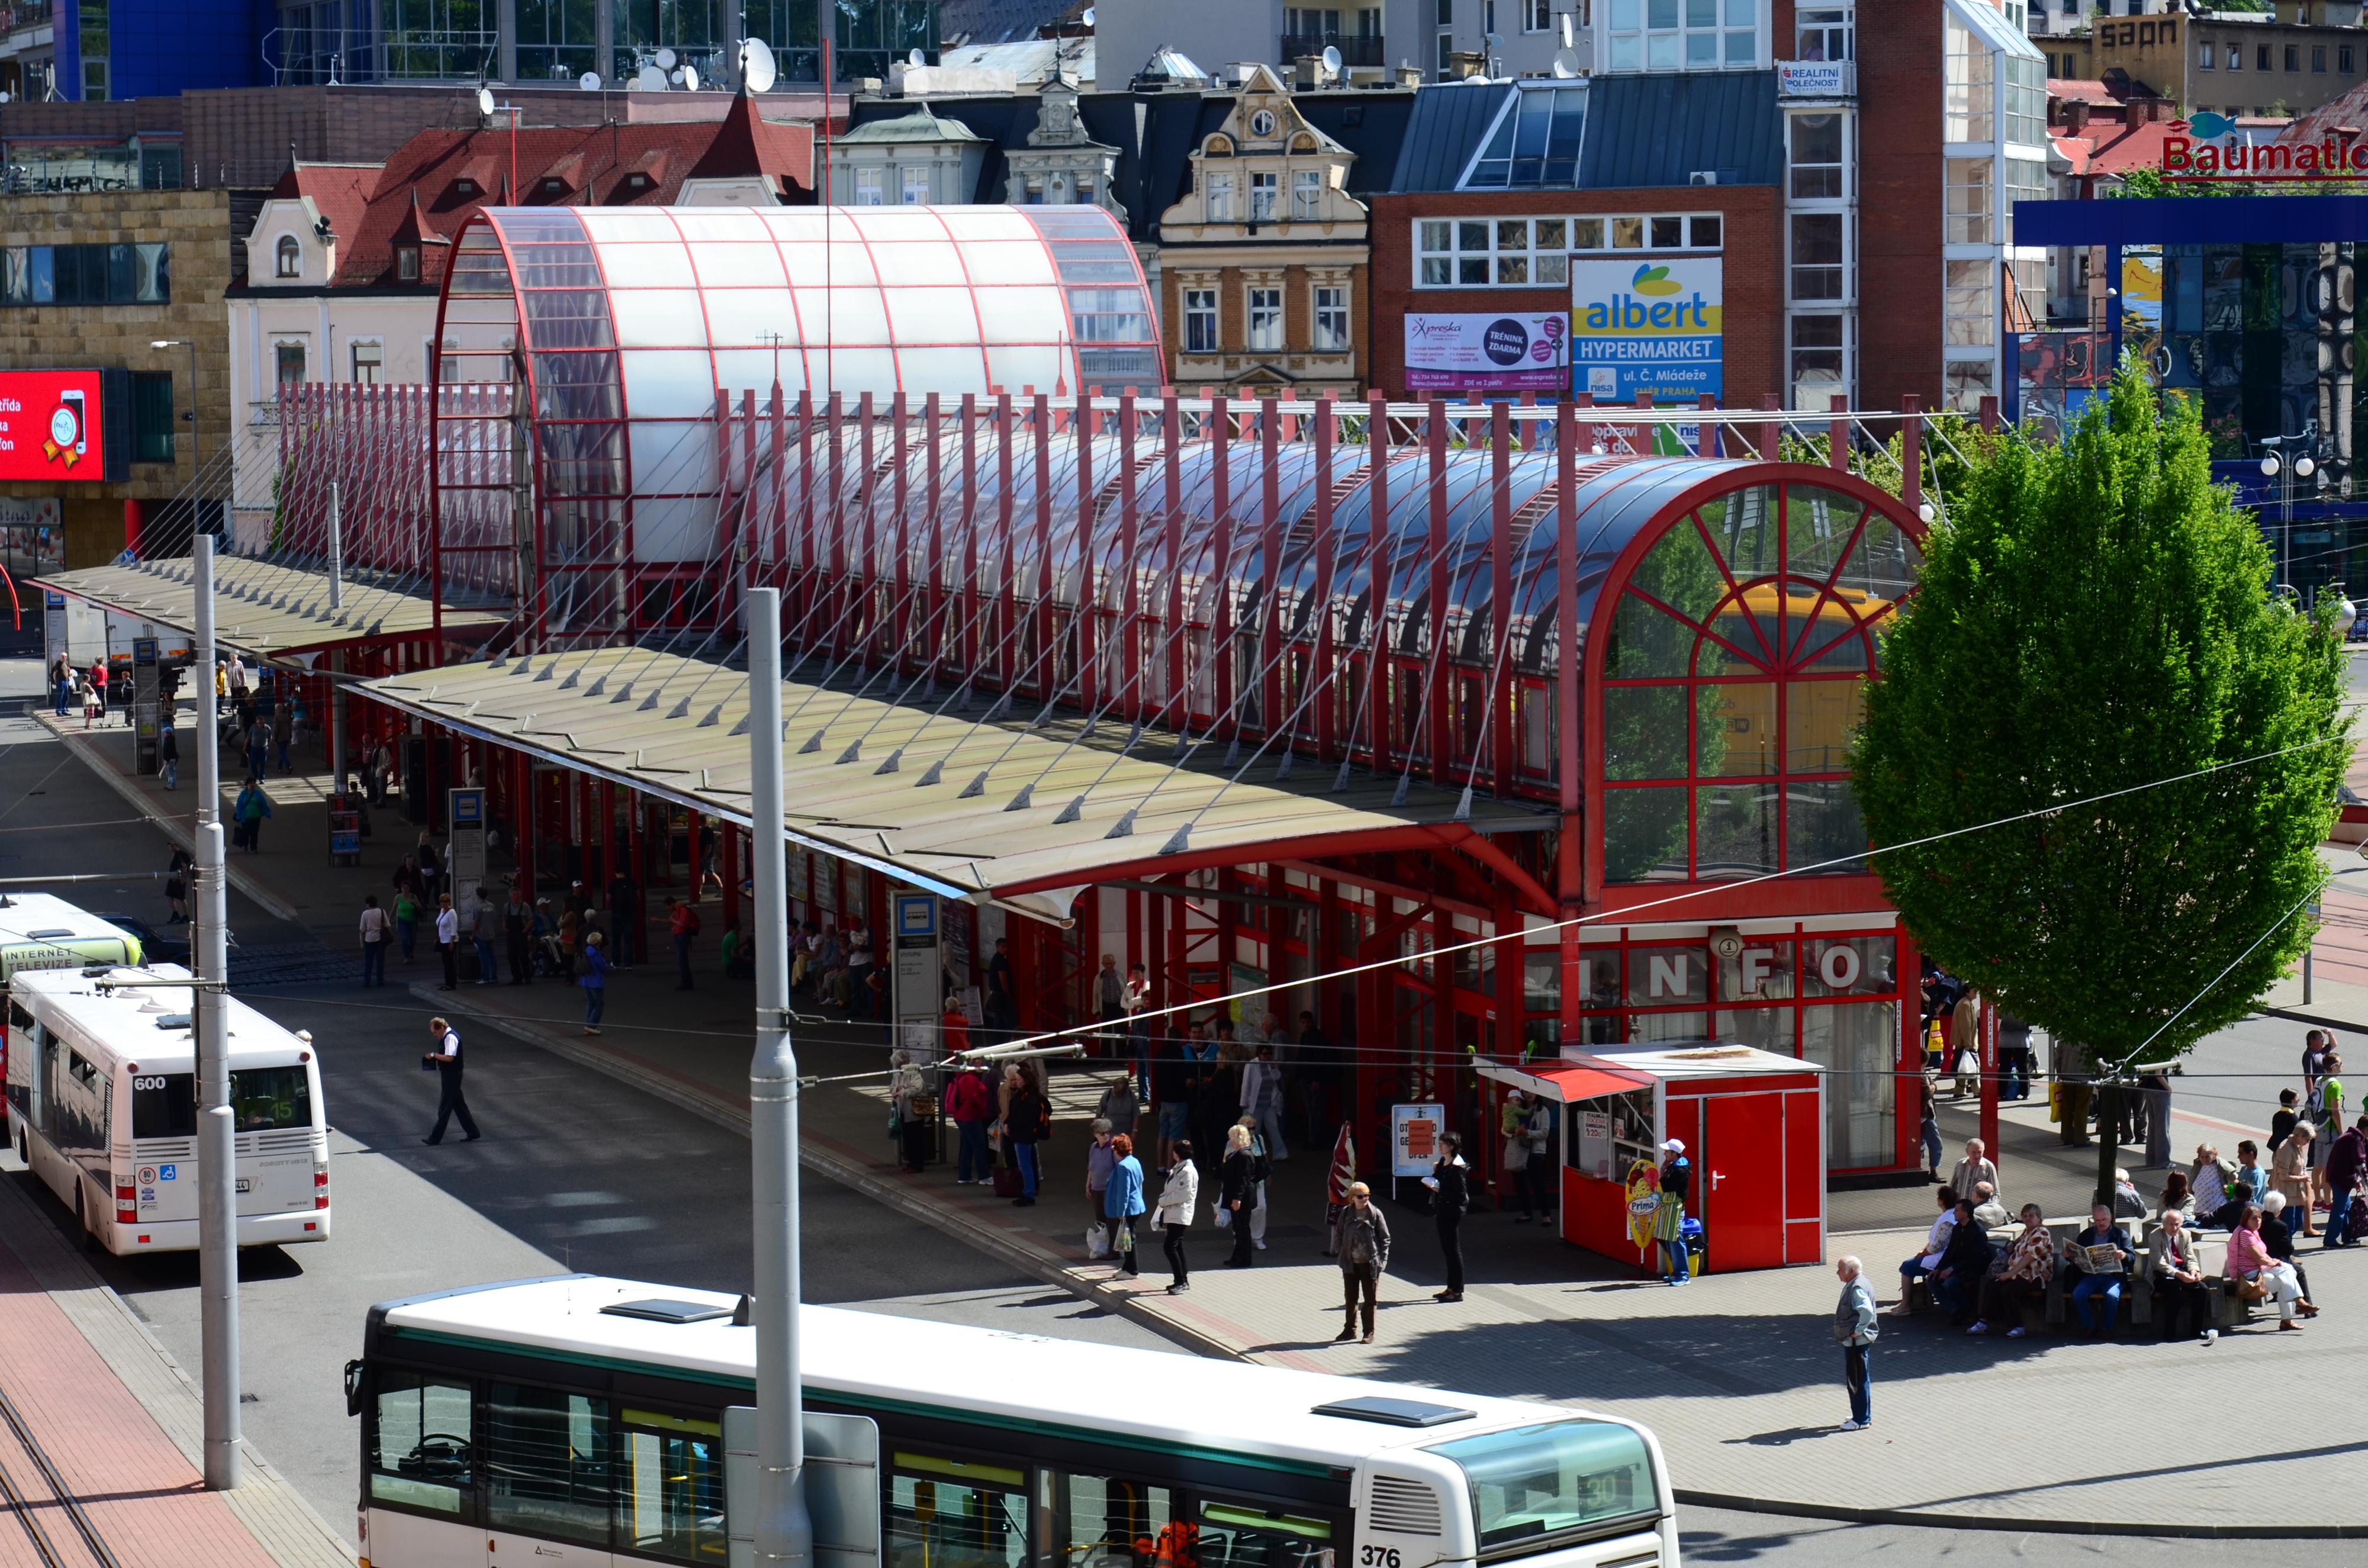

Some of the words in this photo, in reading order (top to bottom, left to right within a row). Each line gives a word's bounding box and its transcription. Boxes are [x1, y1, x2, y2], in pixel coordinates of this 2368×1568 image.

[1792, 67, 1839, 78] REALITNÍ
[1587, 292, 1707, 329] albert
[1490, 331, 1524, 344] TRÉNINK
[1488, 342, 1521, 355] ZDARMA
[1581, 340, 1713, 358] HYPERMARKET
[1624, 370, 1637, 381] ul.
[1640, 368, 1653, 381] Č.
[1656, 369, 1707, 381] Mládeže
[1662, 387, 1697, 395] PRAHA
[1680, 423, 1700, 436] nis
[6, 948, 72, 960] INTERNET
[8, 959, 72, 972] TELEVIZE
[1578, 944, 1861, 1002] INFO
[134, 1076, 166, 1090] 600
[271, 1101, 292, 1119] 15
[1632, 1201, 1654, 1210] Prima
[1587, 1475, 1617, 1509] 30
[1361, 1544, 1401, 1568] 376
